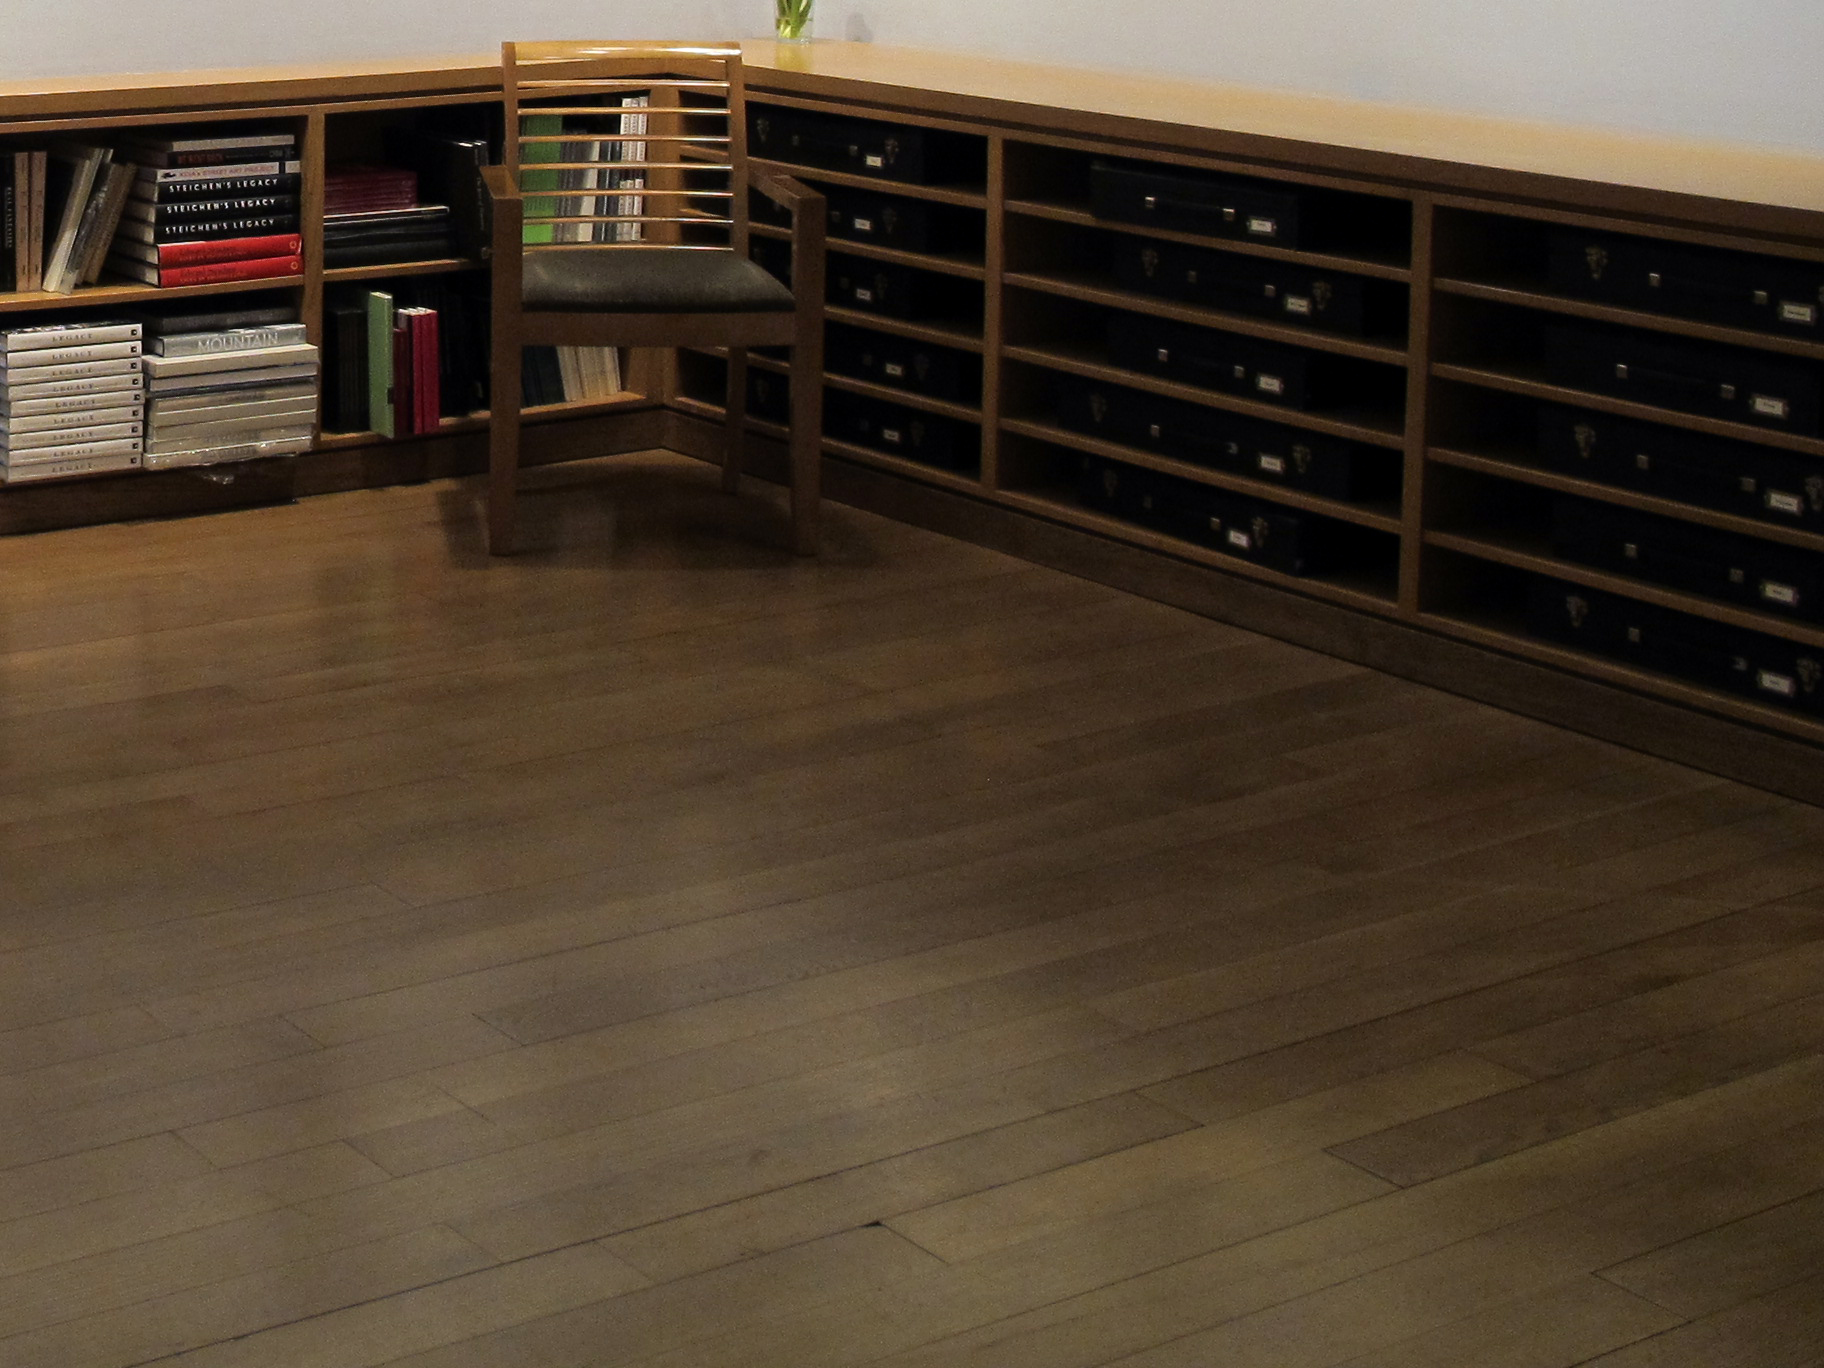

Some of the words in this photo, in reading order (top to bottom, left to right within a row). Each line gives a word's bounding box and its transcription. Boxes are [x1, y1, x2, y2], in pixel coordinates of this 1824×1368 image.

[169, 181, 231, 193] STEICHEN'S
[237, 179, 278, 189] LEGACY
[167, 202, 229, 213] STEICHEN'S
[235, 199, 276, 209] LEGACY
[165, 223, 228, 234] STEICHEN'S
[233, 219, 275, 229] LEGACY
[53, 334, 92, 342] LEGACY
[197, 332, 279, 352] MOUNTAIN
[53, 351, 92, 359] LEGACY
[52, 368, 92, 376] LEGACY
